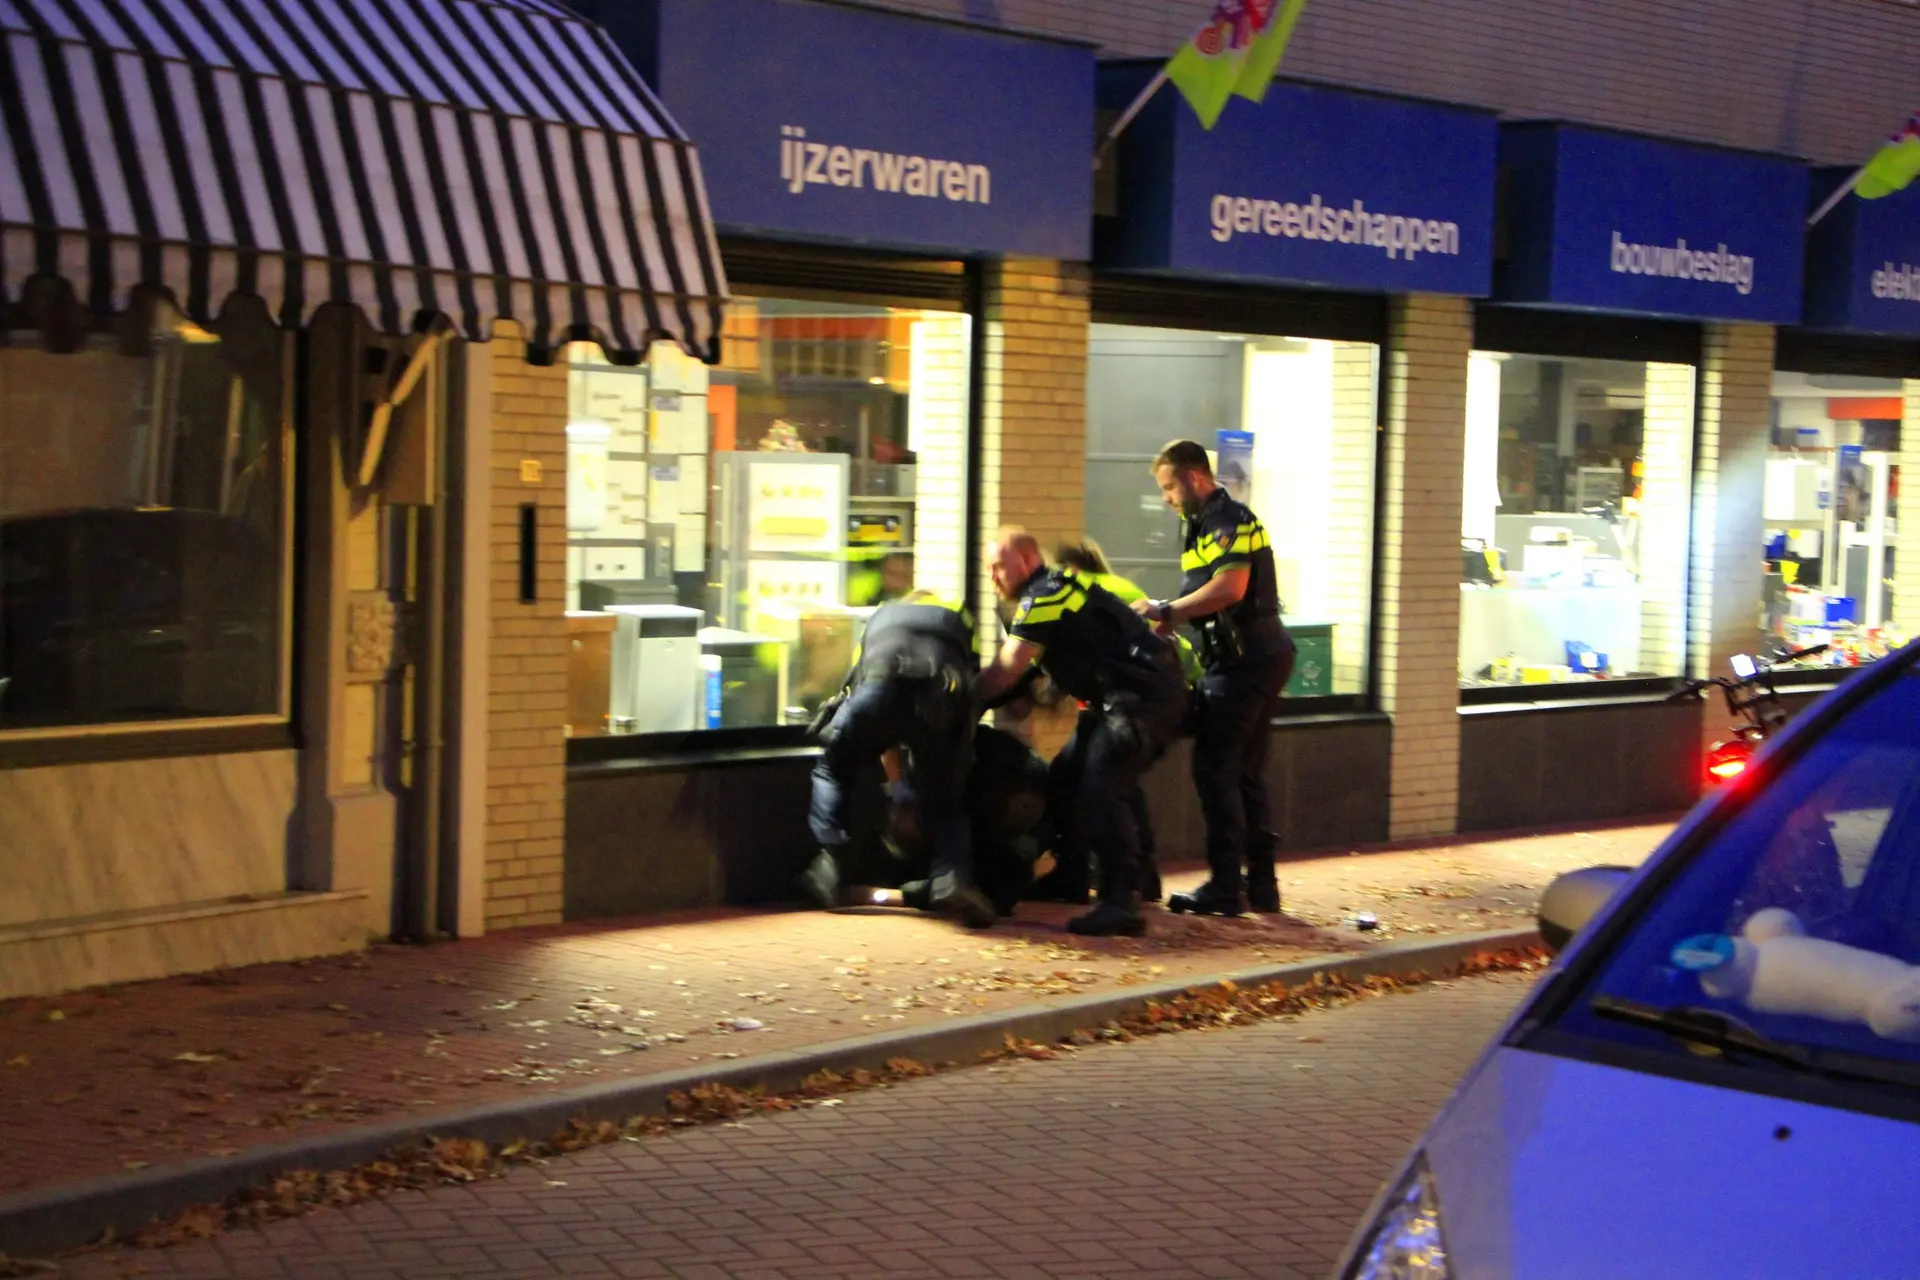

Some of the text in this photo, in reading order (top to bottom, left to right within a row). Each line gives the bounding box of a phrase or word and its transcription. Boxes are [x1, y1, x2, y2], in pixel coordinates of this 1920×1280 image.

[781, 124, 990, 204] ijzerwaren
[1210, 193, 1459, 261] gereedschappen
[1611, 230, 1754, 295] bouwbeslag
